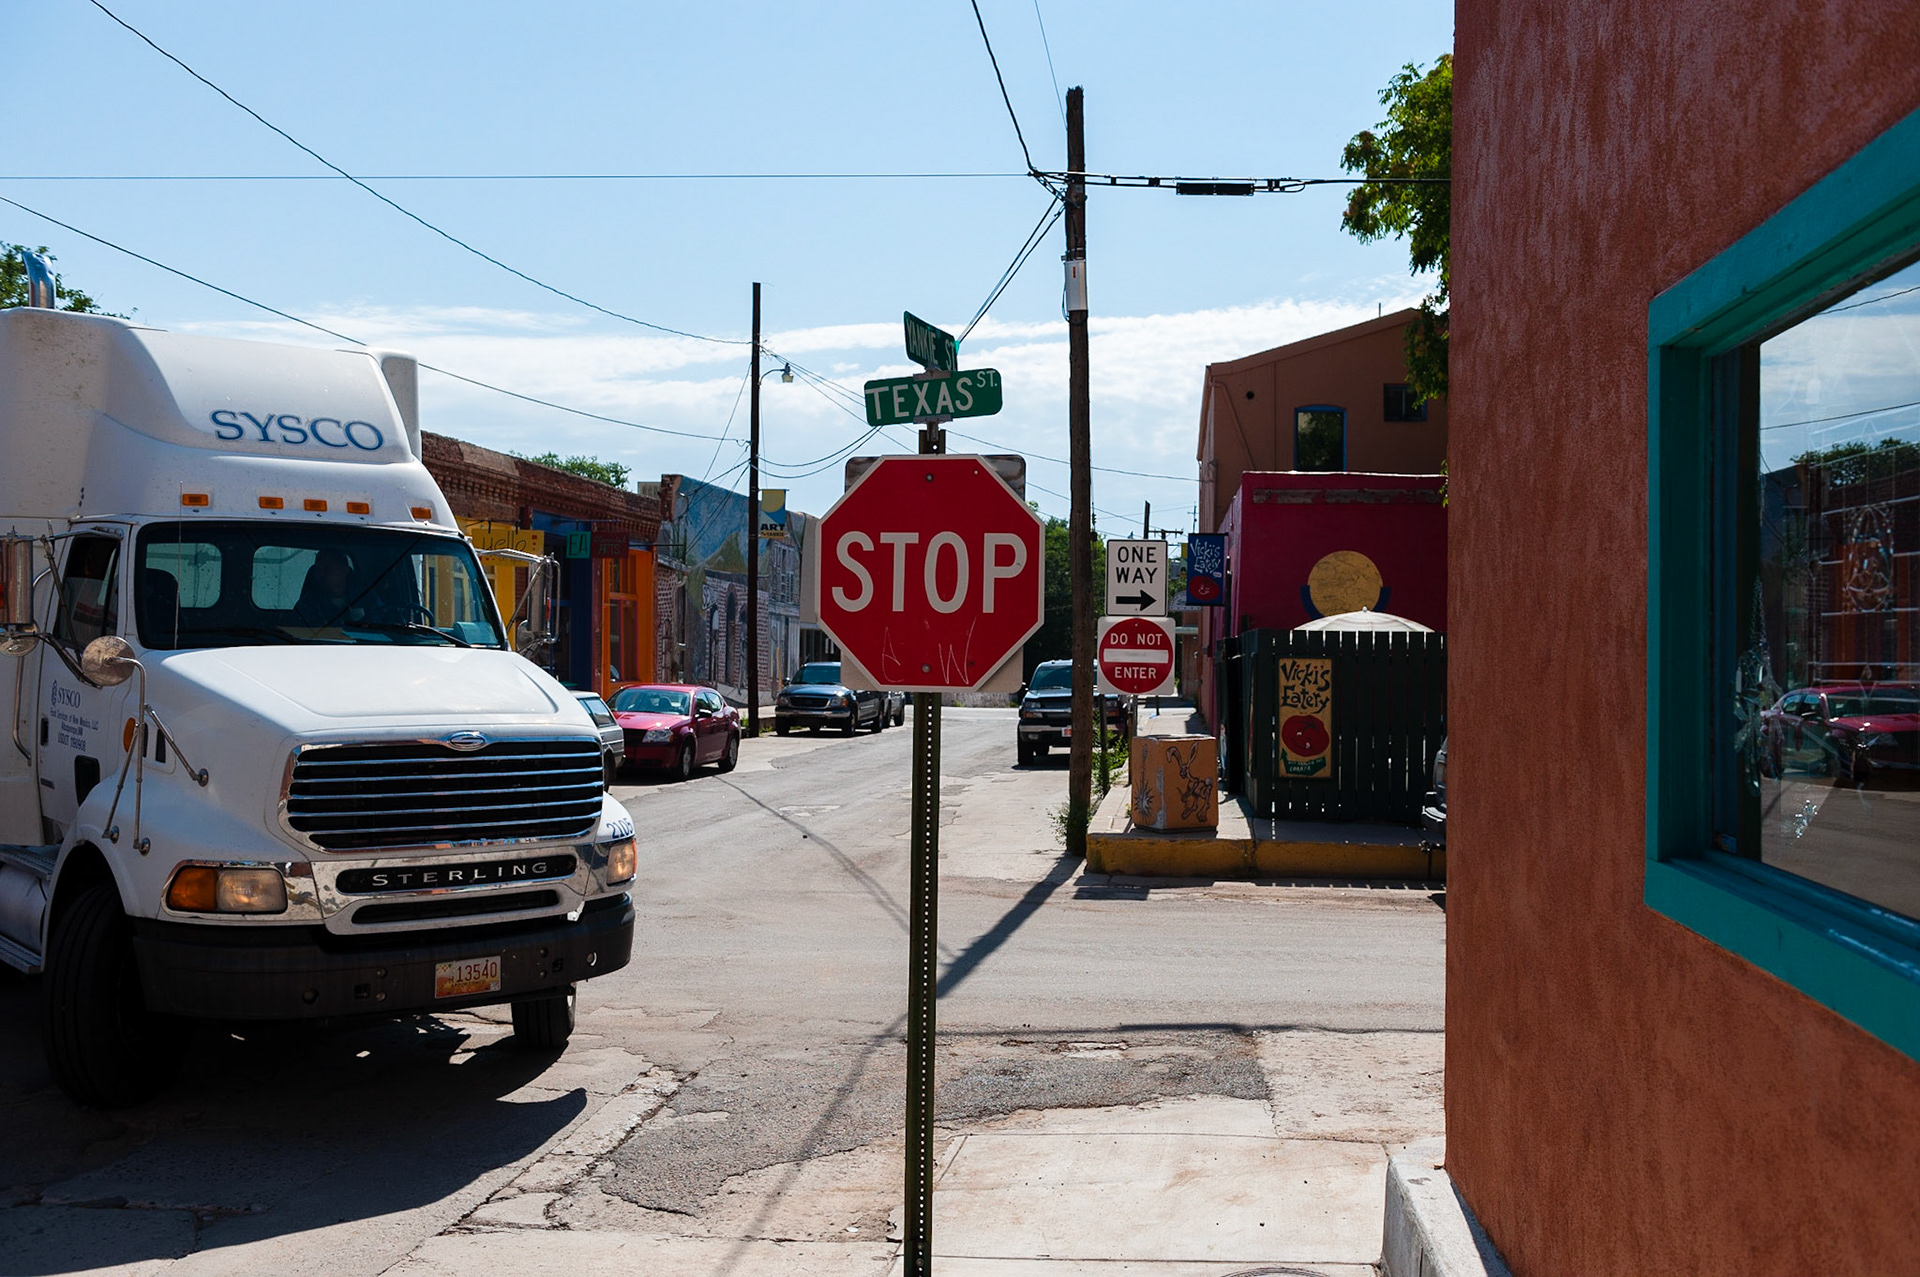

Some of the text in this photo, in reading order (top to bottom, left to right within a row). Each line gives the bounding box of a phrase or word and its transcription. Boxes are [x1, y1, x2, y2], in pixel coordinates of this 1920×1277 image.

[906, 319, 939, 366] YANKIE
[865, 370, 998, 420] TEXAS ST.
[210, 409, 385, 451] SYSCO
[1117, 546, 1157, 564] ONE
[1189, 538, 1221, 560] Vicki's
[832, 531, 1028, 614] STOP
[1116, 567, 1158, 584] WAY
[1194, 556, 1221, 574] Eatery
[1110, 633, 1163, 646] DO NOT
[1114, 666, 1157, 680] ENTER
[1280, 660, 1331, 692] Vicki's
[58, 687, 81, 708] SYSCO
[1280, 685, 1331, 715] Eatery
[606, 817, 634, 839] 2105
[371, 861, 550, 887] STERLING
[456, 961, 498, 983] 13540
